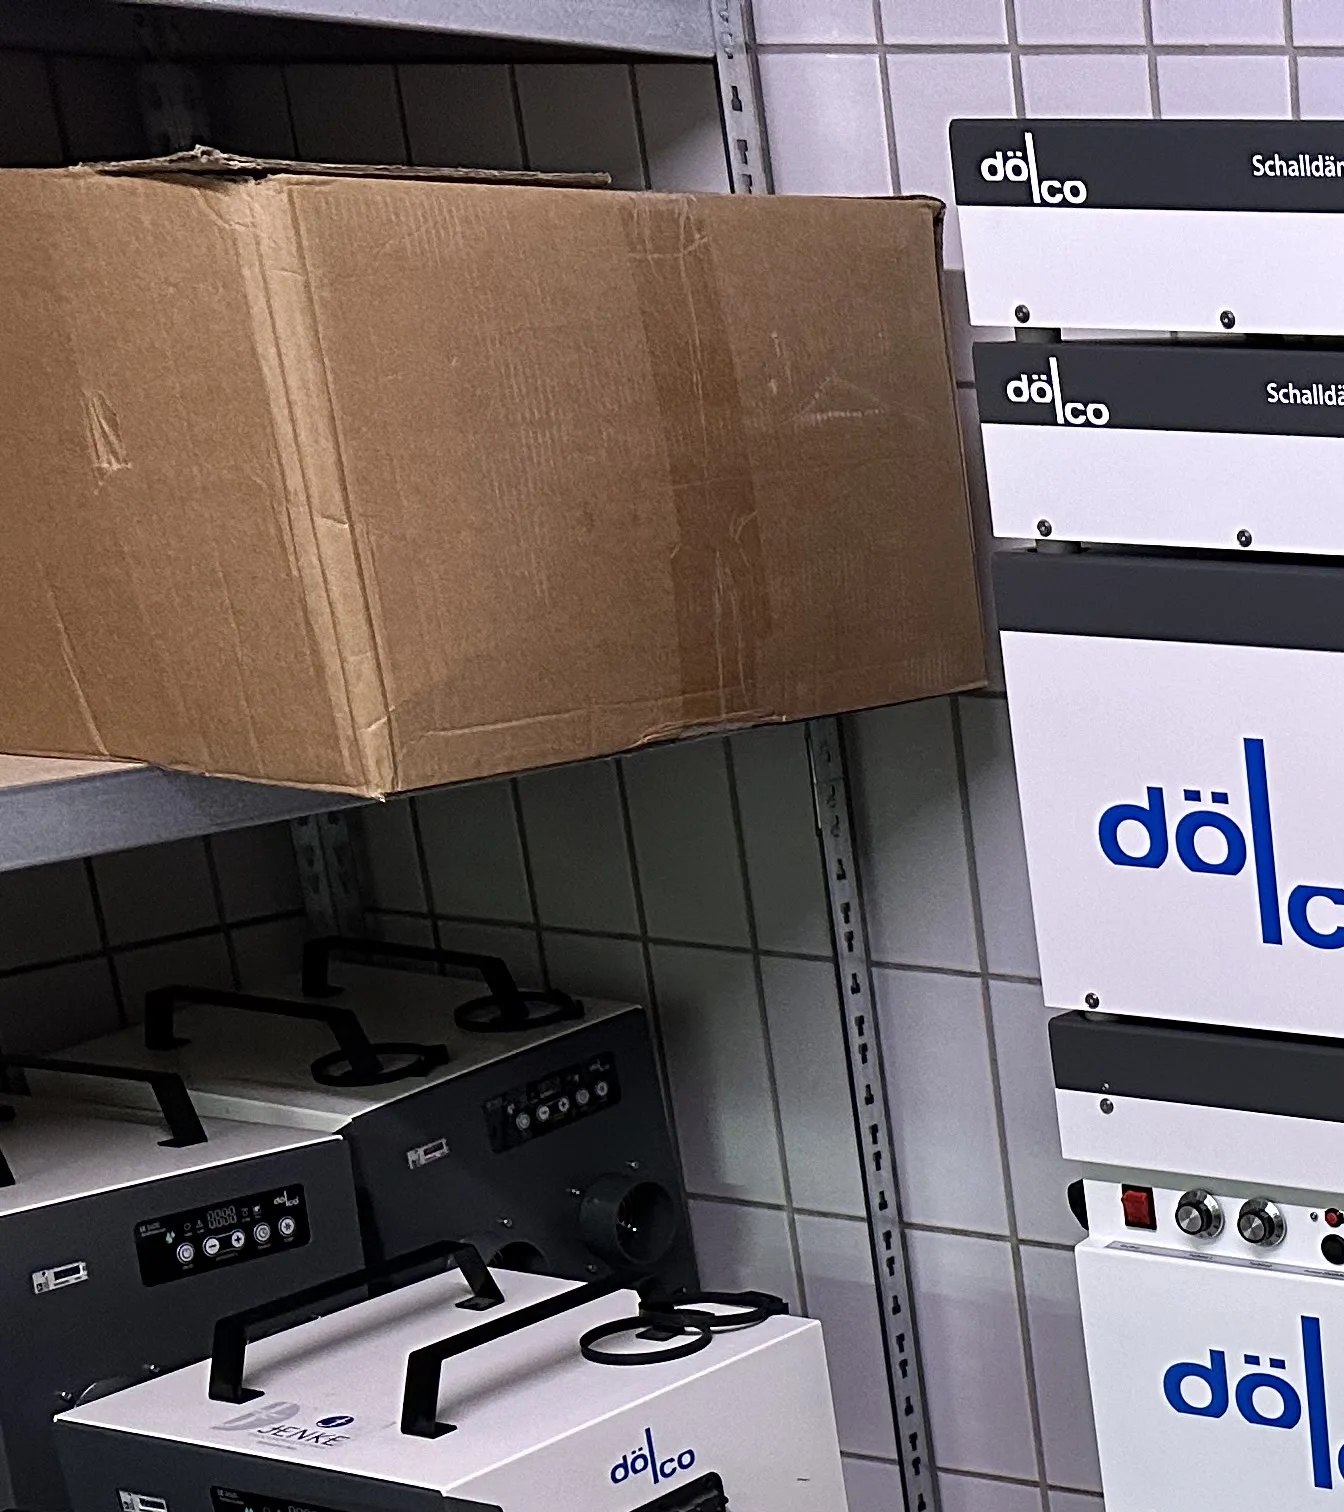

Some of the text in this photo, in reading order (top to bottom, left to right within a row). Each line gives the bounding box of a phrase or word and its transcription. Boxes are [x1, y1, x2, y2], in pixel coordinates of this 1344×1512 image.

[981, 132, 1086, 203] dölco
[1006, 357, 1110, 425] dölco
[257, 1424, 350, 1446] JENKE
[611, 1428, 694, 1484] dölco
